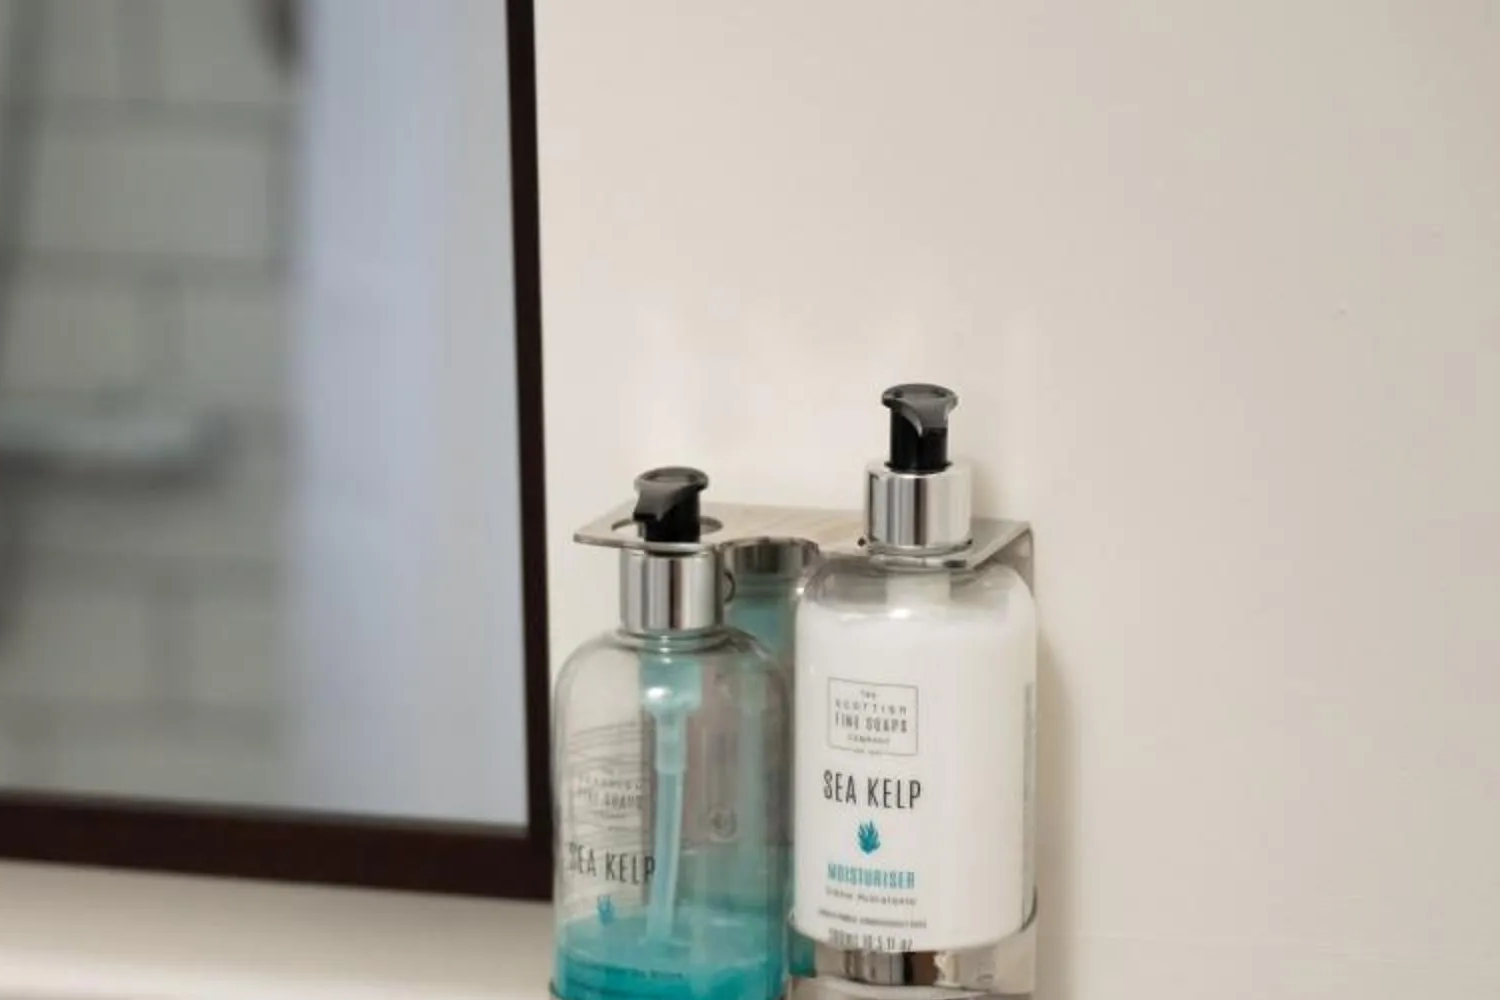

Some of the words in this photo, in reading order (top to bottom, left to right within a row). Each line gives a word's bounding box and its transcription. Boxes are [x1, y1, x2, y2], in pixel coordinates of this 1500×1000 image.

[835, 711, 859, 730] FINE
[865, 716, 908, 734] SOAPS
[823, 769, 857, 804] SEA
[867, 776, 921, 809] KELP
[568, 841, 597, 877] SEA
[606, 850, 655, 886] KELP
[827, 862, 915, 889] MOISTURISER
